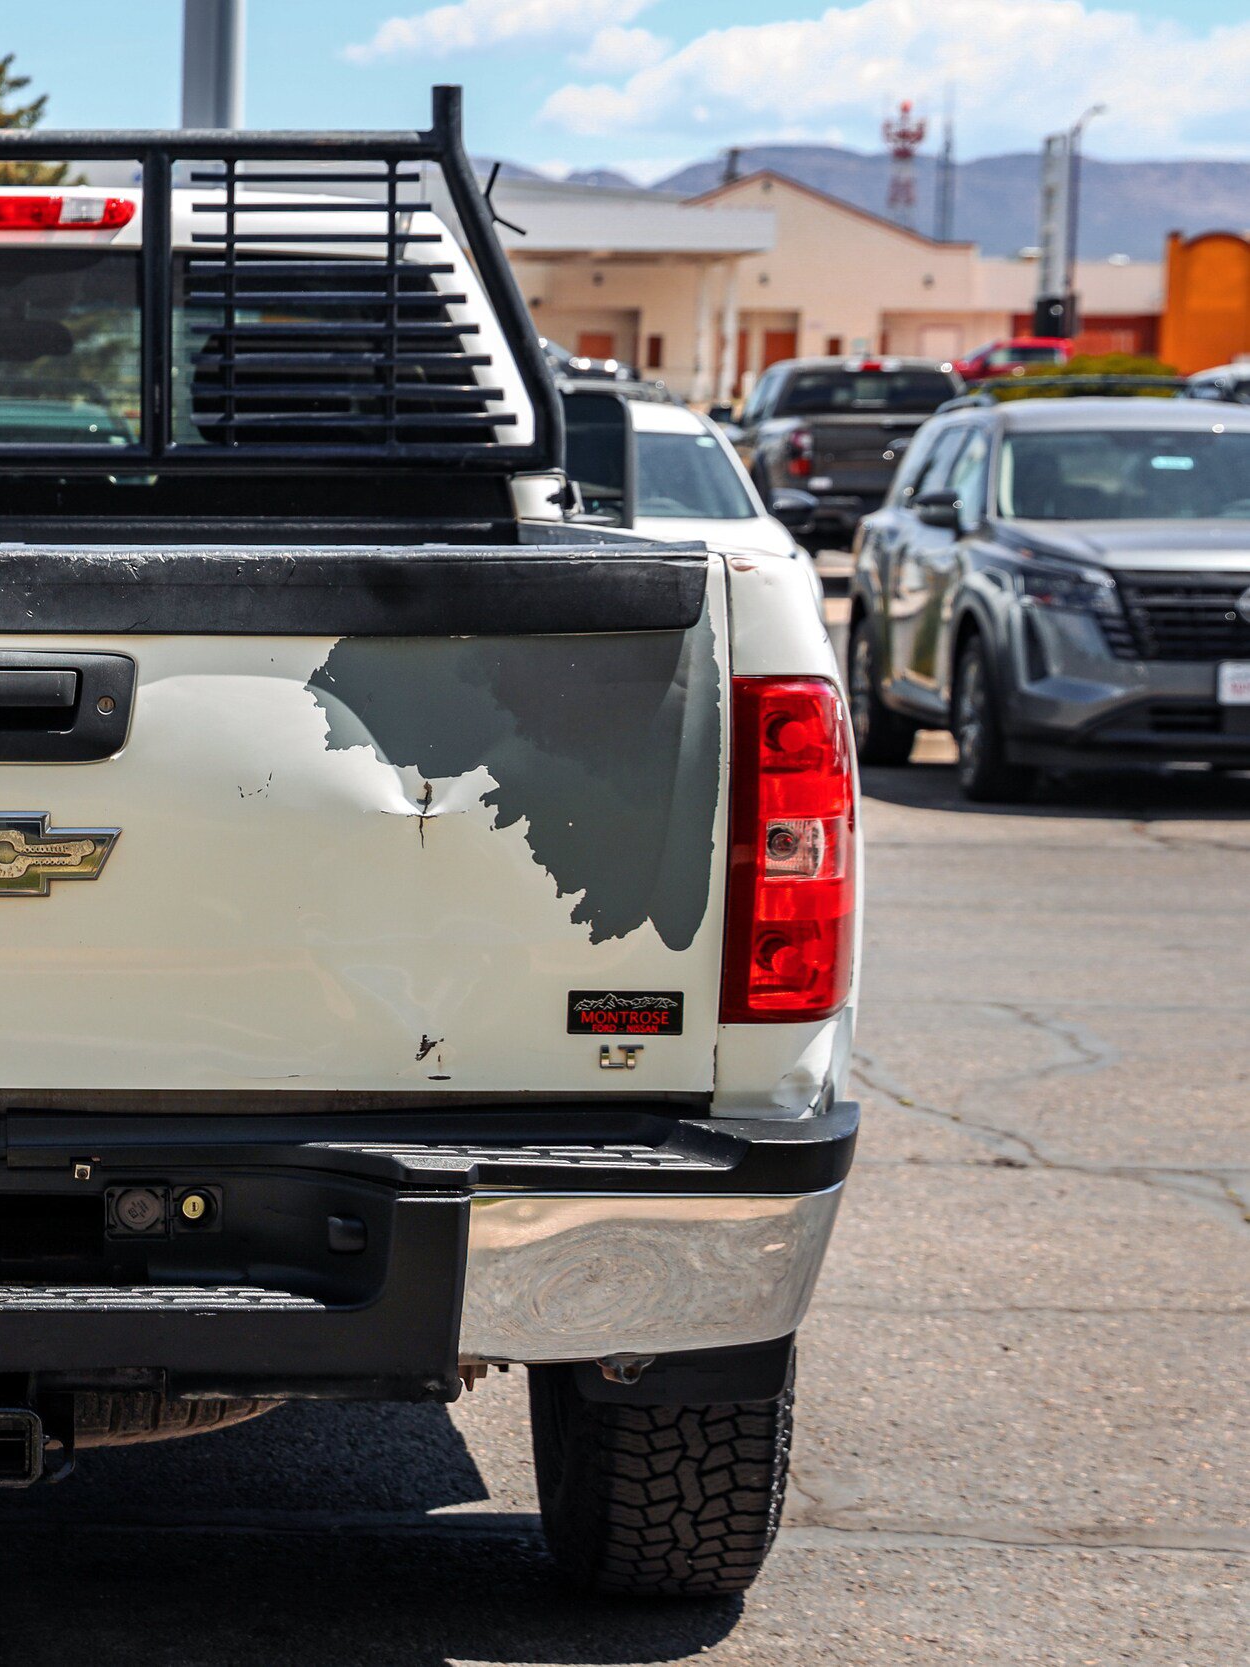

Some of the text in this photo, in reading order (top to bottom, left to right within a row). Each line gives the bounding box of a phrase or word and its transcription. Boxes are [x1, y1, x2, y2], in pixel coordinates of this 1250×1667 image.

[581, 1011, 669, 1025] MONTROSE
[592, 1024, 617, 1033] FORD
[626, 1024, 659, 1033] NISSAN
[600, 1044, 644, 1069] LT
